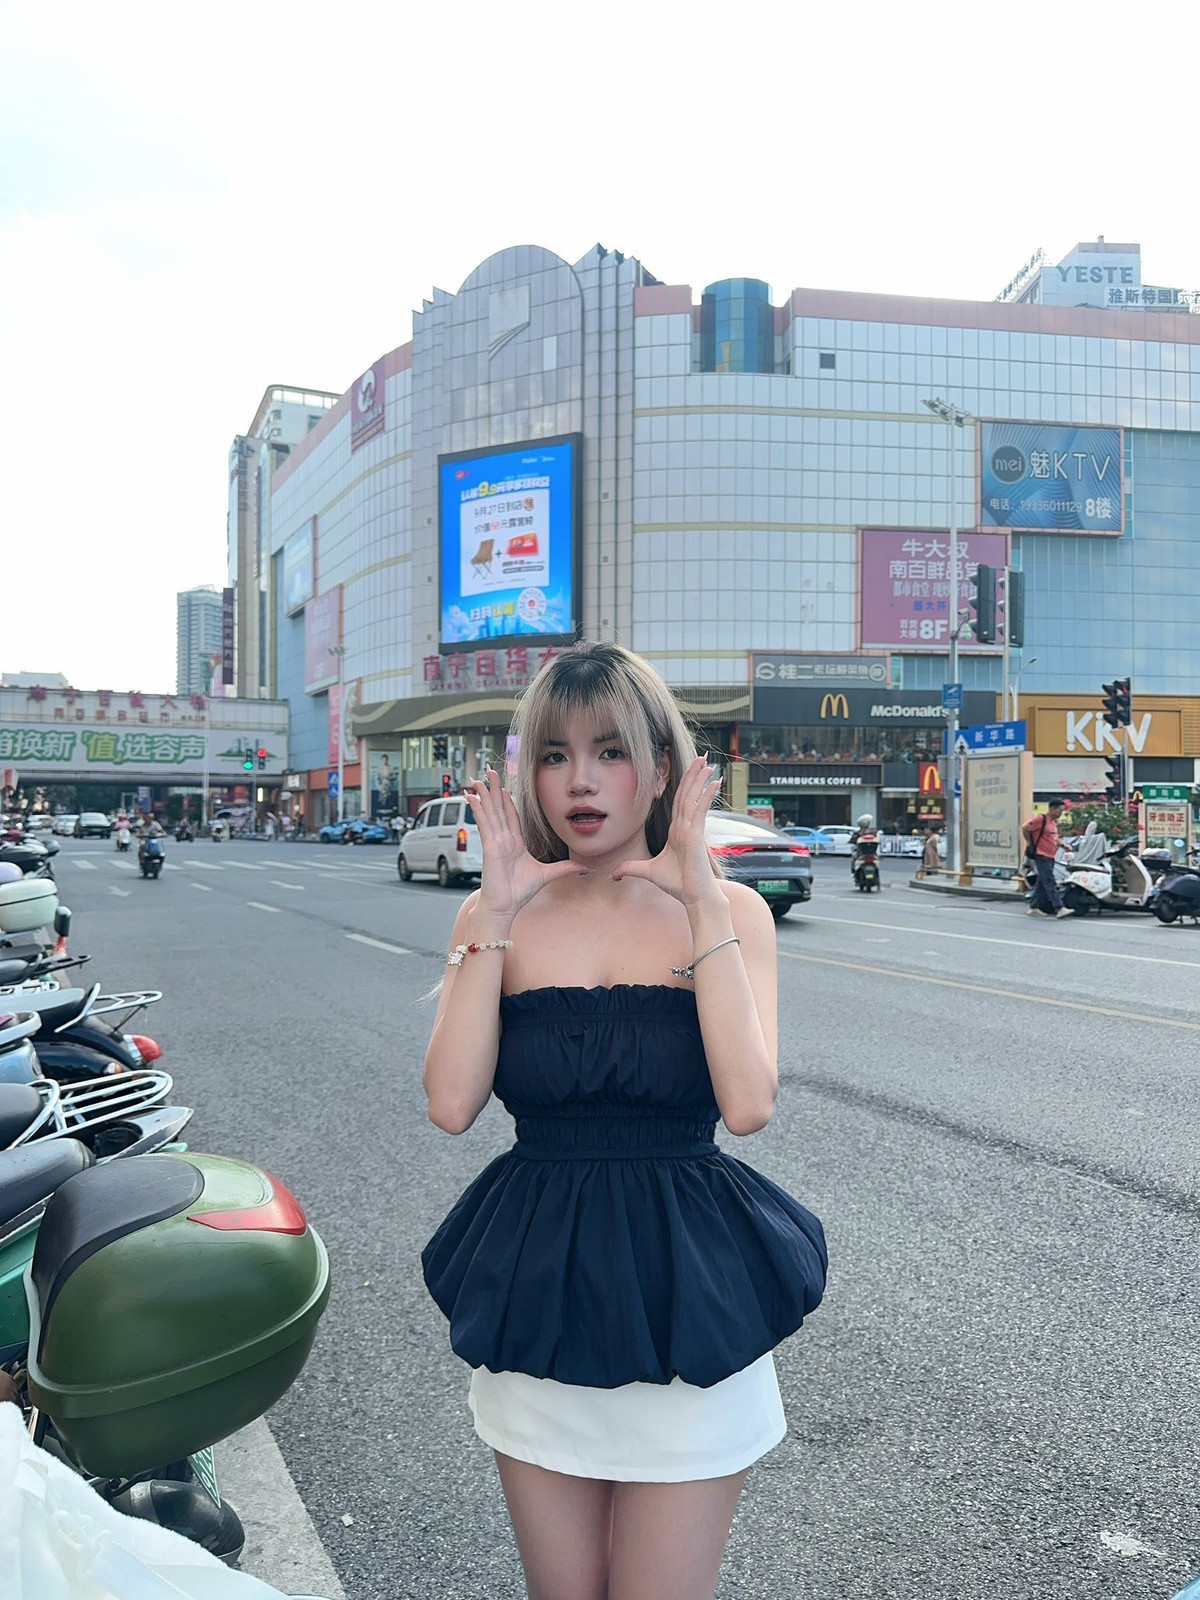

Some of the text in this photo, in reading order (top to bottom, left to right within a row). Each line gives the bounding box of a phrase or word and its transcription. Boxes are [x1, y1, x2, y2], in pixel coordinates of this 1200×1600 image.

[1056, 265, 1133, 284] YESTE
[995, 456, 1022, 472] mei
[920, 618, 948, 640] 8F
[870, 705, 948, 717] McDonald's
[975, 728, 1014, 743] 新华路
[770, 777, 862, 785] STARBUCKS COFFEE
[975, 831, 997, 842] 3960
